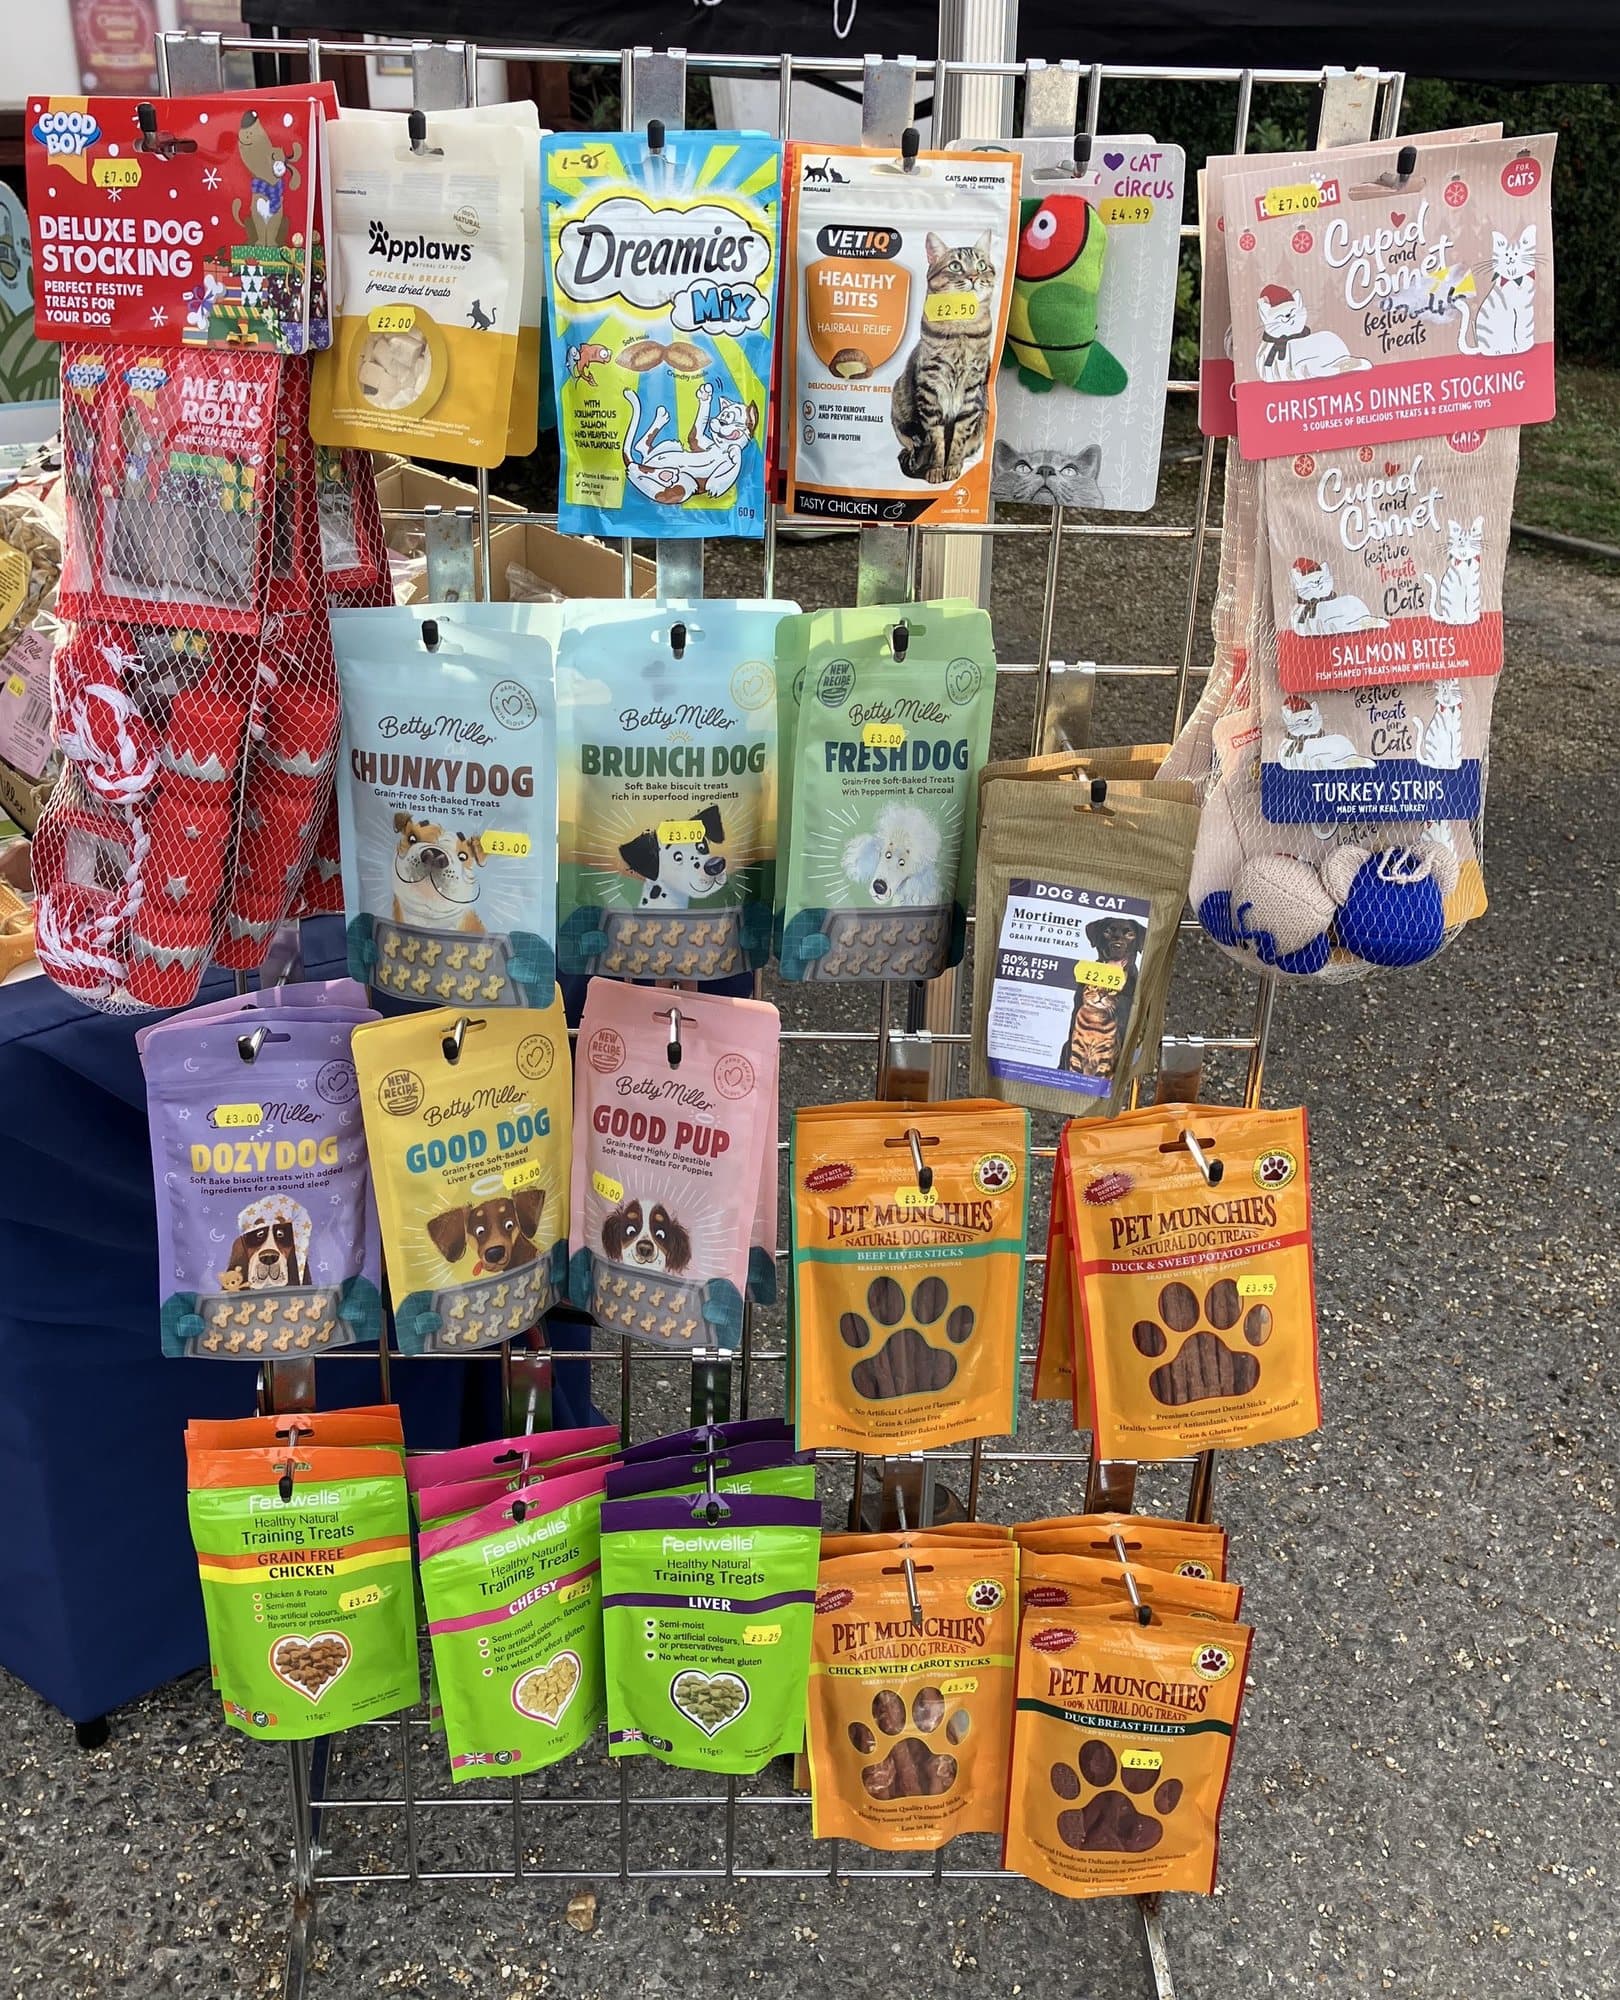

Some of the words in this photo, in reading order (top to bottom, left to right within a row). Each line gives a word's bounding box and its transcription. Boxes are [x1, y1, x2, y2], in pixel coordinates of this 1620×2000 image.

[38, 111, 98, 135] GOOD
[46, 131, 88, 156] BOY
[1130, 153, 1162, 172] CAT
[1514, 163, 1530, 172] FOR
[104, 171, 138, 184] £7.00
[945, 175, 961, 183] CATS
[962, 175, 978, 183] AND
[978, 175, 1006, 184] KITTENS
[1507, 171, 1534, 187] CATS
[1279, 195, 1318, 212] £7.00
[1111, 208, 1150, 220] £4.99
[39, 215, 137, 243] DELUXE
[143, 219, 204, 246] DOG
[368, 232, 472, 264] Applaws
[827, 229, 891, 252] VETIQ
[42, 244, 193, 279] STOCKING
[574, 224, 754, 284] Dreamies
[1388, 241, 1417, 265] and
[368, 269, 416, 283] CHICKEN
[418, 273, 458, 285] BREAST
[818, 271, 897, 291] HEALTHY
[44, 280, 93, 296] PERFECT
[95, 282, 144, 297] FESTIVE
[365, 279, 397, 295] freeze
[398, 284, 424, 297] dried
[424, 286, 451, 298] treats
[45, 295, 88, 310] TREATS
[91, 297, 116, 310] FOR
[691, 287, 756, 326] Mix
[833, 292, 878, 308] BITES
[45, 309, 80, 324] YOUR
[83, 311, 112, 325] DOG
[937, 303, 976, 317] £2.50
[378, 316, 412, 330] £2.00
[818, 322, 860, 335] HAIRBALL
[863, 324, 893, 336] RELIEF
[1378, 323, 1427, 354] treats
[181, 376, 268, 403] MEATY
[1266, 390, 1364, 424] CHRISTMAS
[1369, 381, 1436, 411] DINNER
[1441, 370, 1527, 402] STOCKING
[182, 402, 264, 429] ROLLS
[1309, 418, 1343, 431] COURSES
[1344, 415, 1354, 427] OF
[1355, 411, 1394, 426] DELICIOUS
[1395, 406, 1423, 421] TREATS
[1424, 406, 1430, 417] &
[1438, 400, 1473, 416] EXCITING
[1473, 398, 1492, 411] TOYS
[738, 507, 755, 518] 60g
[800, 496, 826, 512] TASTY
[828, 499, 878, 516] CHICKEN
[1376, 557, 1416, 584] treats
[1383, 583, 1426, 617] Cats
[1332, 642, 1406, 668] SALMON
[1412, 636, 1456, 661] BITES
[829, 664, 850, 676] NEW
[823, 674, 851, 687] RECIPE
[378, 715, 436, 741] Betty
[435, 716, 494, 746] Miller
[870, 734, 902, 745] £3.00
[581, 744, 706, 778] BRUNCH
[712, 742, 766, 778] DOG
[825, 741, 910, 773] FRESH
[912, 739, 968, 772] DOG
[351, 748, 463, 794] CHUNKY
[465, 762, 534, 798] DOG
[374, 788, 418, 802] Grain-Free
[420, 792, 470, 806] Soft-Baked
[470, 798, 500, 808] Treats
[611, 792, 630, 801] rich
[631, 792, 640, 801] in
[642, 792, 689, 803] superfood
[691, 791, 740, 802] ingredients
[1312, 782, 1385, 802] TURKEY
[1391, 780, 1444, 800] STRIPS
[388, 800, 408, 812] with
[408, 803, 426, 813] less
[428, 805, 450, 816] than
[450, 806, 466, 816] 5%
[467, 808, 484, 818] Fat
[1336, 804, 1356, 813] MADE
[1358, 804, 1378, 813] WITH
[1379, 804, 1398, 812] REAL
[1400, 803, 1426, 812] TURKEY
[668, 831, 702, 843] £3.00
[491, 840, 528, 855] £3.00
[1035, 883, 1074, 901] DOG
[1078, 892, 1090, 904] &
[1095, 895, 1126, 910] CAT
[1012, 907, 1082, 928] Mortimer
[1008, 932, 1033, 942] GRAIN
[1034, 934, 1052, 944] FREE
[1051, 938, 1080, 949] TREATS
[1002, 954, 1029, 967] 80%
[1030, 956, 1058, 970] FISH
[1000, 964, 1045, 980] TREATS
[1085, 970, 1121, 986] £2.95
[226, 1114, 260, 1124] £3.00
[593, 1104, 667, 1145] GOOD
[674, 1121, 730, 1159] PUP
[406, 1128, 488, 1174] GOOD
[496, 1108, 550, 1151] DOG
[190, 1140, 272, 1174] DOZY
[276, 1136, 340, 1171] DOG
[512, 1168, 540, 1185] £3.00
[200, 1186, 252, 1196] ingredients
[254, 1184, 268, 1193] for
[270, 1184, 276, 1192] a
[278, 1182, 305, 1190] sound
[307, 1178, 331, 1191] sleep
[904, 1194, 936, 1205] £3.95
[828, 1204, 870, 1241] PET
[874, 1200, 994, 1232] MUNCHIES
[1110, 1214, 1154, 1250] PET
[1158, 1194, 1278, 1235] MUNCHIES
[845, 1230, 900, 1247] NATURAL
[902, 1229, 931, 1246] DOG
[931, 1230, 974, 1244] TREATS
[857, 1252, 886, 1262] BEEF
[888, 1250, 923, 1261] LIVER
[924, 1248, 964, 1259] STICKS
[1111, 1262, 1145, 1272] DUCK
[1146, 1261, 1156, 1270] &
[1157, 1256, 1198, 1270] SWEET
[1198, 1248, 1244, 1264] POTATO
[1244, 1239, 1282, 1254] STICKS
[1246, 1283, 1274, 1294] £3.95
[242, 1530, 305, 1546] Training
[308, 1525, 355, 1542] Treats
[258, 1550, 306, 1566] GRAIN
[311, 1548, 345, 1562] FREE
[269, 1564, 335, 1580] CHICKEN
[349, 1592, 378, 1609] £3.25
[509, 1580, 558, 1616] CHEESY
[688, 1596, 732, 1612] LIVER
[658, 1620, 705, 1630] Semi-moist
[752, 1632, 780, 1642] £3.25
[828, 1666, 878, 1676] CHICKEN
[878, 1664, 909, 1675] WITH
[910, 1660, 954, 1672] CARROT
[954, 1658, 991, 1666] STICKS
[1064, 1712, 1097, 1726] DUCK
[1098, 1718, 1142, 1732] BREAST
[1142, 1722, 1186, 1734] FILLETS
[1130, 1758, 1160, 1768] £3.95
